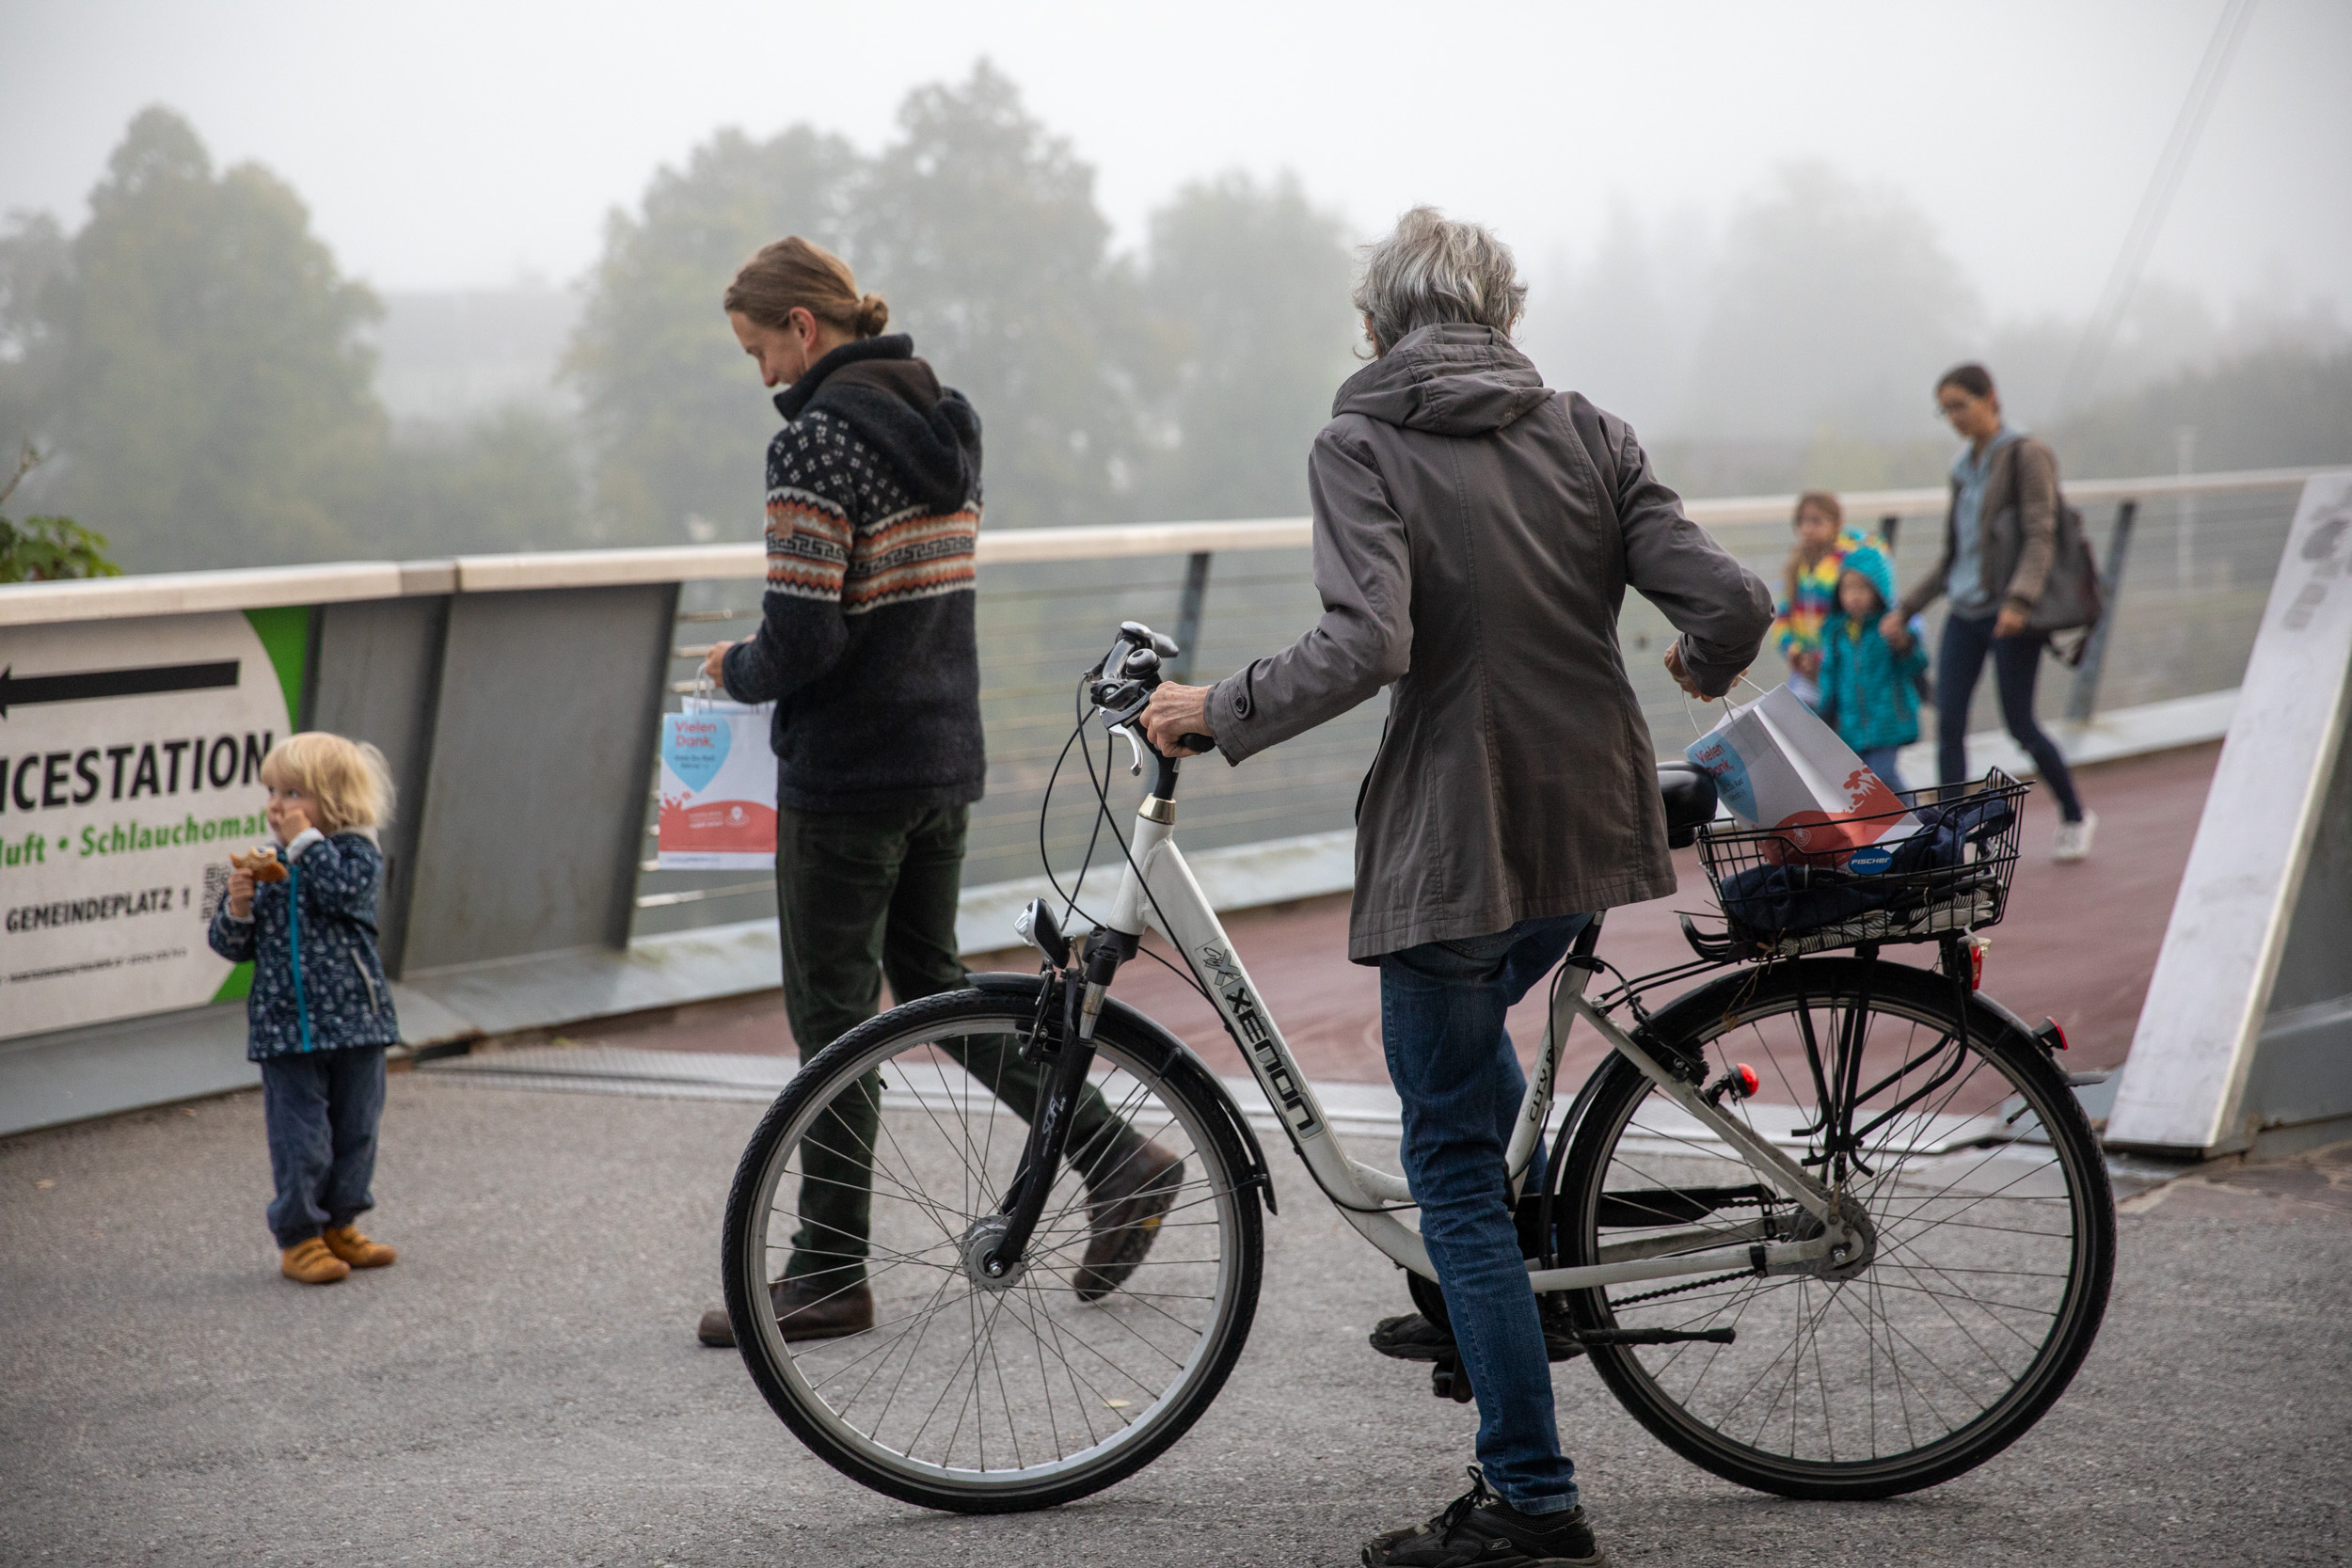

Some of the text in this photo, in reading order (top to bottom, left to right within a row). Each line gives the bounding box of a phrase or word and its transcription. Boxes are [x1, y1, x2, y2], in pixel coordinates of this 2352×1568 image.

[1694, 744, 1725, 764] Vielen
[79, 809, 267, 857] Schlauchomat
[6, 886, 173, 933] GEMEINDEPLATZ
